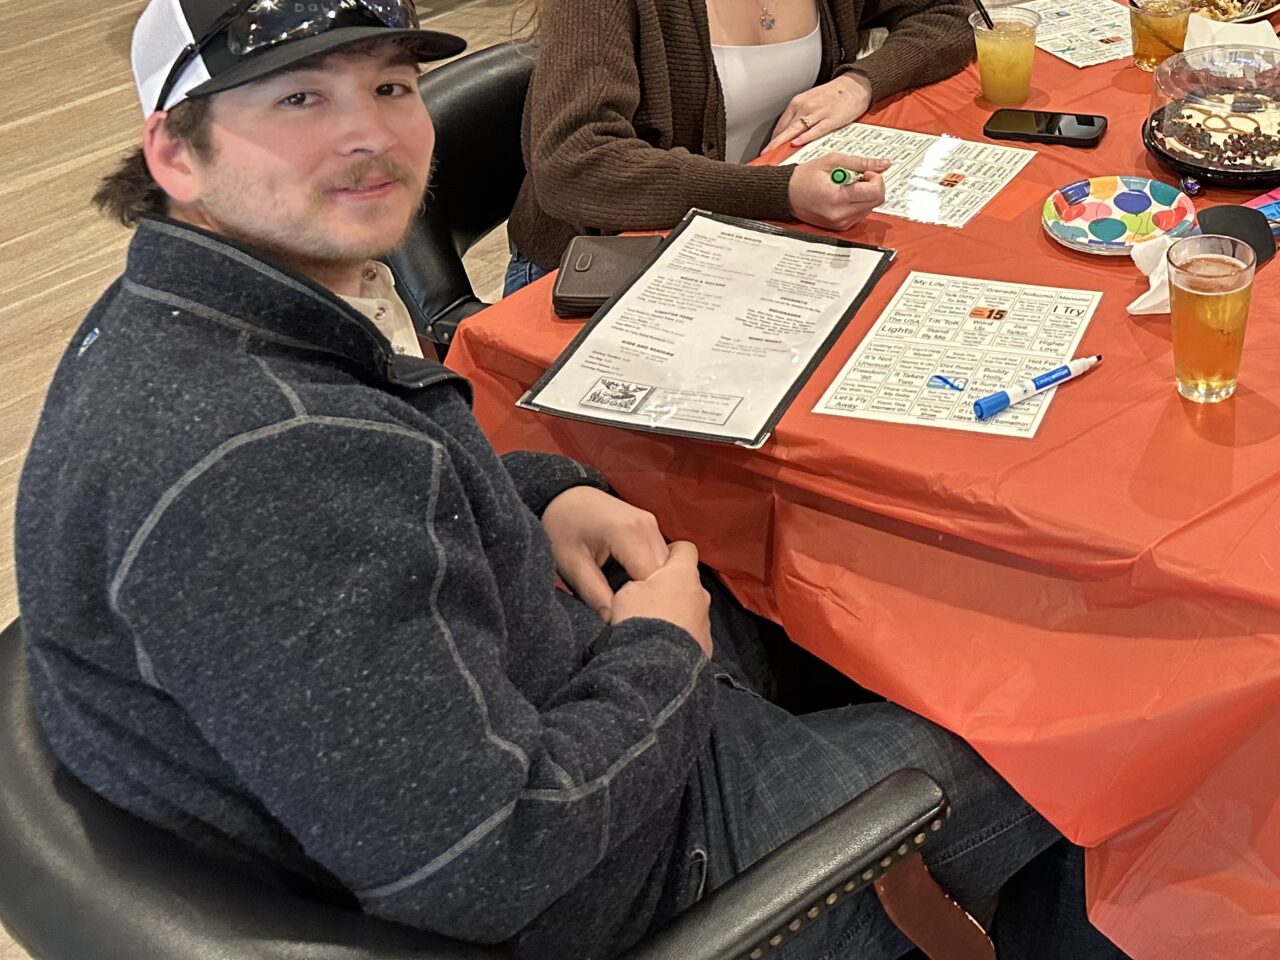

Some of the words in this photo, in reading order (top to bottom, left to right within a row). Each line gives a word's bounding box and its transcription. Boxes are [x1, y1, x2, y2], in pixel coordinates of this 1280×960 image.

[983, 308, 1007, 320] 15
[1052, 304, 1058, 312] I
[1059, 305, 1085, 317] Try
[879, 324, 915, 335] Lights
